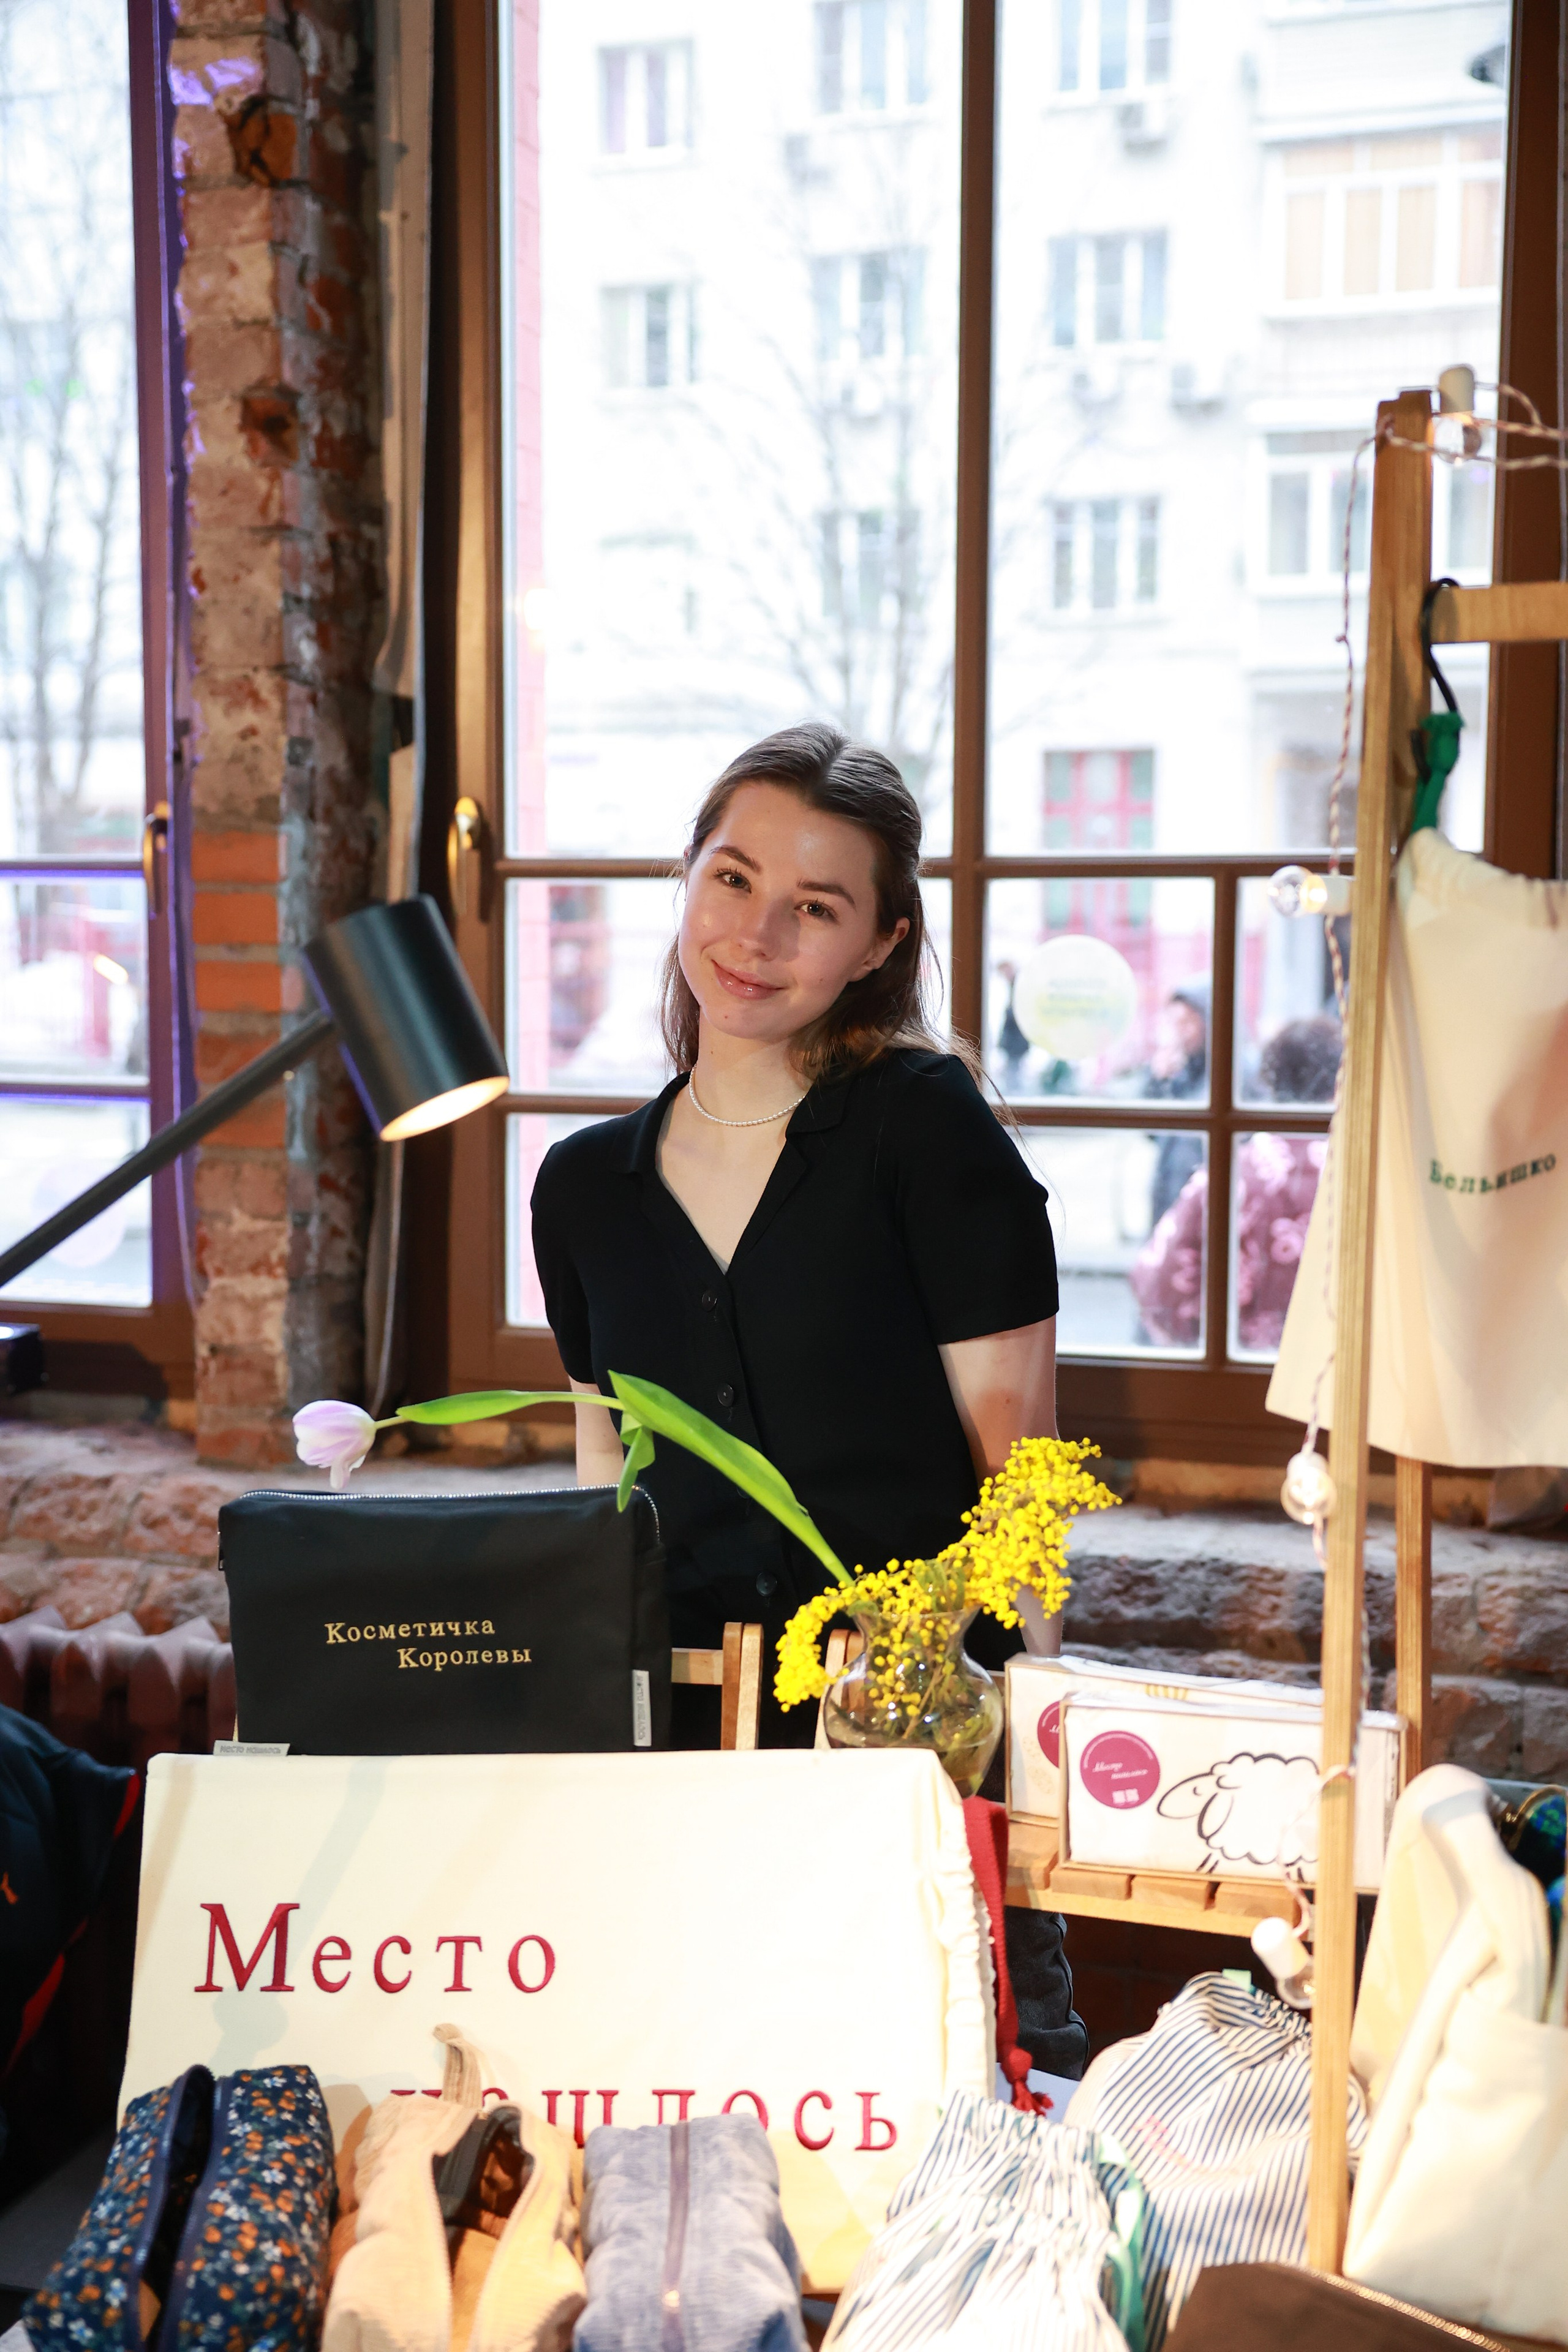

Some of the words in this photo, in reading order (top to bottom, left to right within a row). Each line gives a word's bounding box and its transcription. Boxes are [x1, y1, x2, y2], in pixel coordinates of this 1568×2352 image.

[324, 1619, 496, 1645] Косметичка
[397, 1647, 532, 1672] Королевы
[194, 1902, 556, 1994] Место
[390, 2087, 898, 2151] шлось
